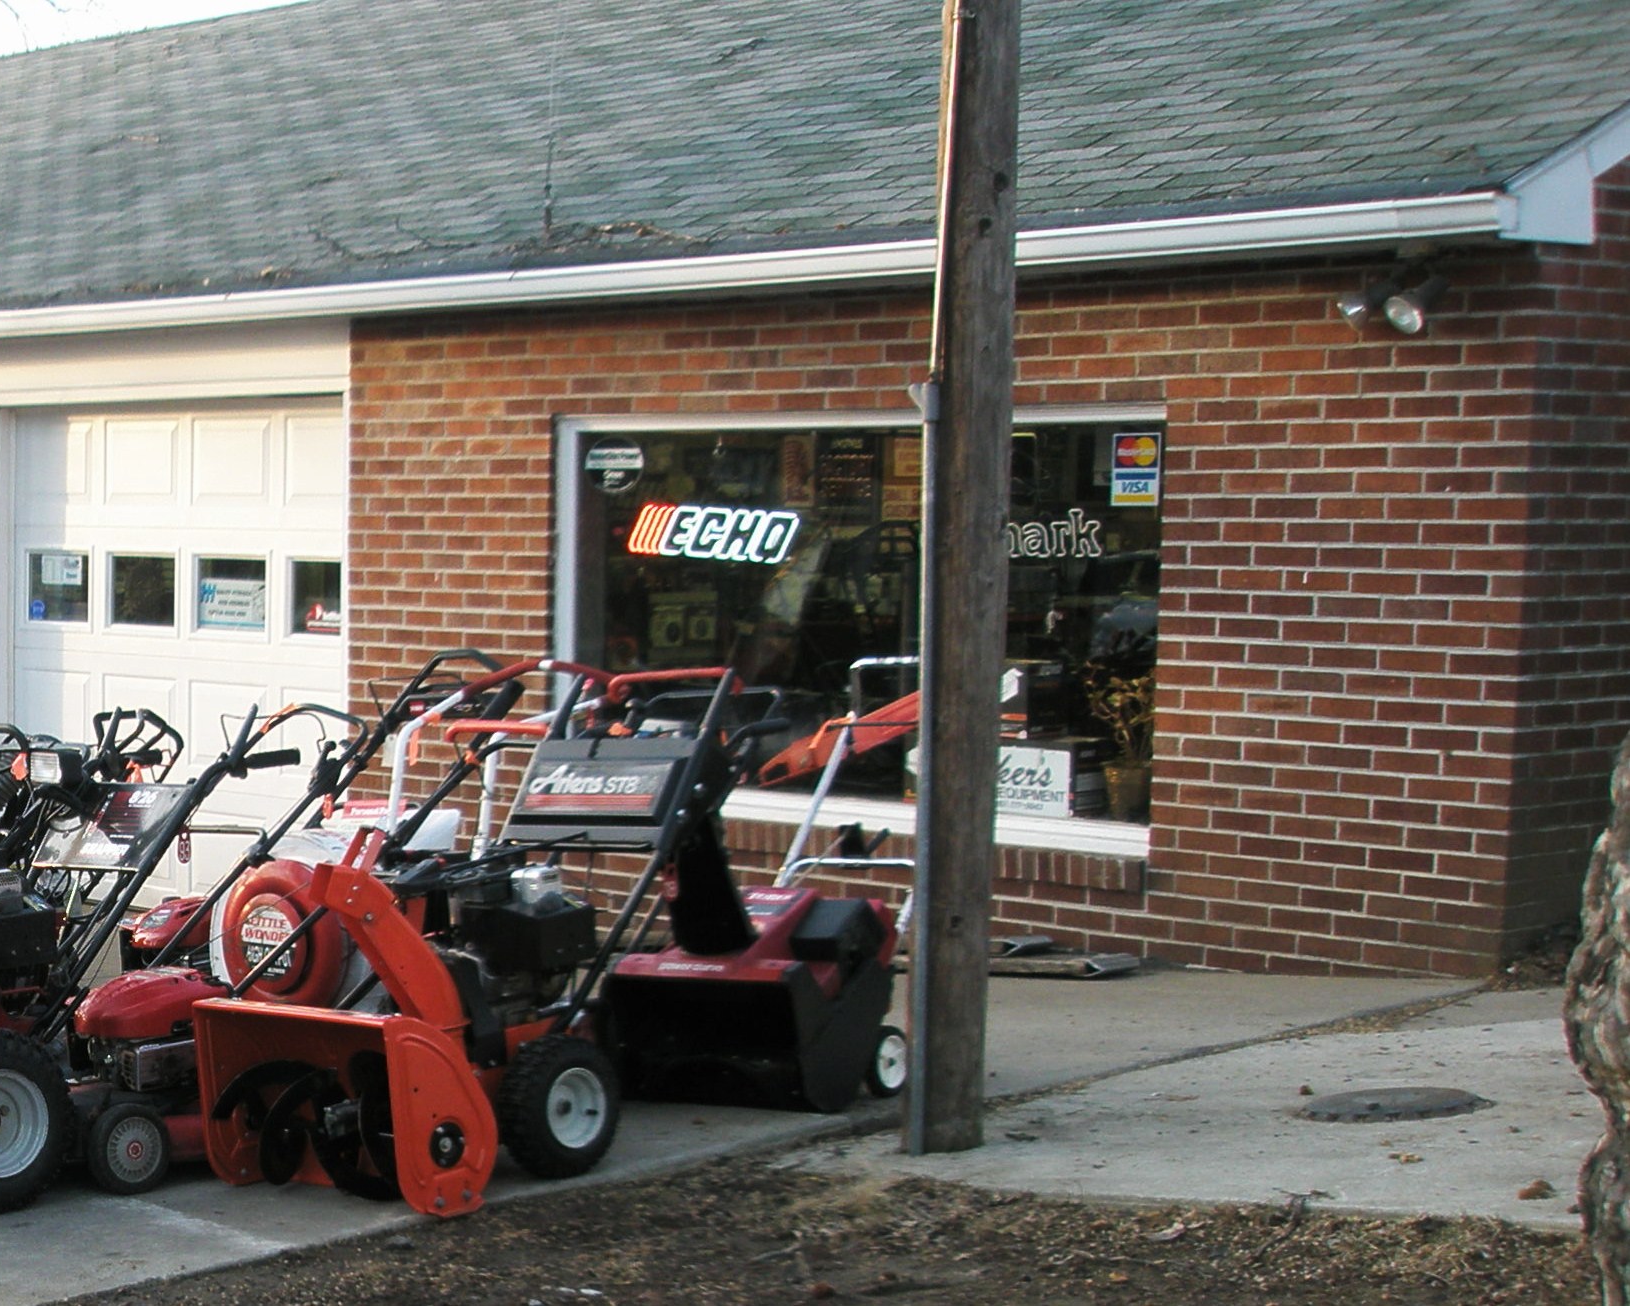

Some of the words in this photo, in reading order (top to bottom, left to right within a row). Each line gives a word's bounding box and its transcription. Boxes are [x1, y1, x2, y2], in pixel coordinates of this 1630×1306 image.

[1121, 481, 1150, 494] VISA
[658, 505, 801, 564] ECHO
[528, 764, 604, 795] Ariens
[128, 790, 159, 804] 826
[997, 787, 1066, 803] EQUIPMENT
[244, 928, 290, 943] WONDE
